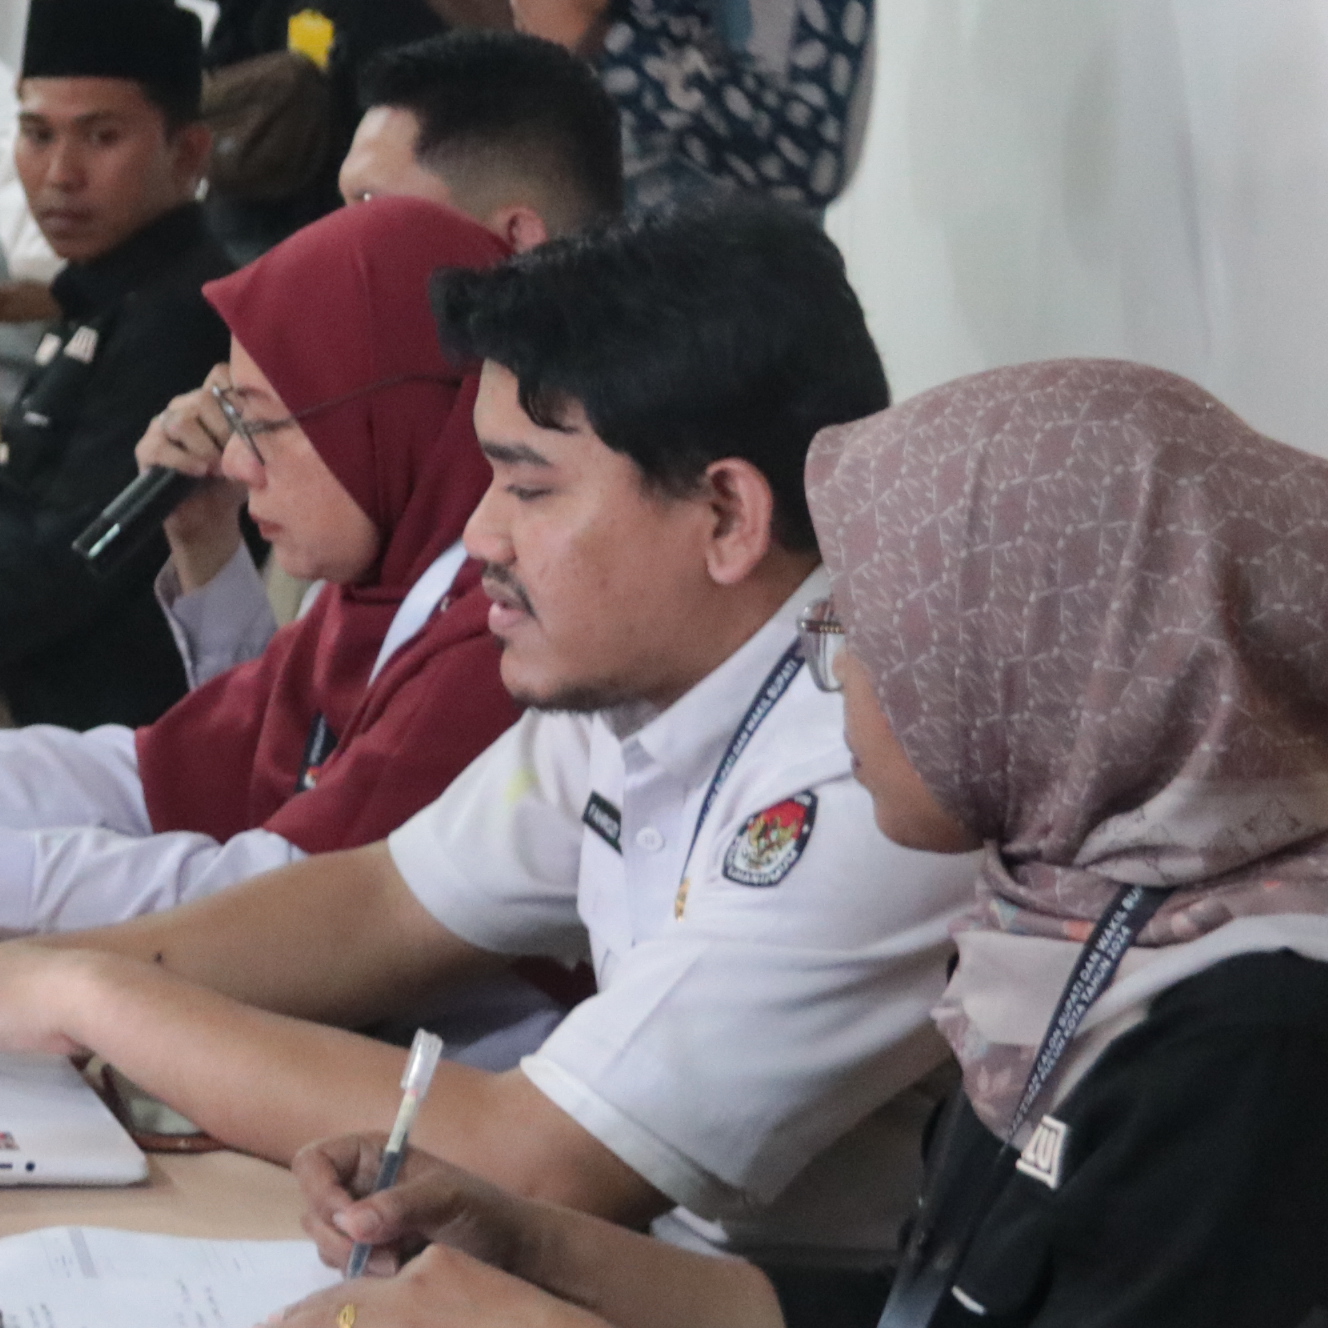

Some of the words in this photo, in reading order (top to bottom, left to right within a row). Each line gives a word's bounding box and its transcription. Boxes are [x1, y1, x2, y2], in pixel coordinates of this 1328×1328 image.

[764, 657, 798, 701] BUPATI
[1060, 1000, 1086, 1038] KOTA
[1078, 956, 1112, 1004] TAHUN
[1105, 924, 1132, 959] 2024
[1077, 949, 1102, 982] DAN
[1094, 908, 1128, 952] WAKIL
